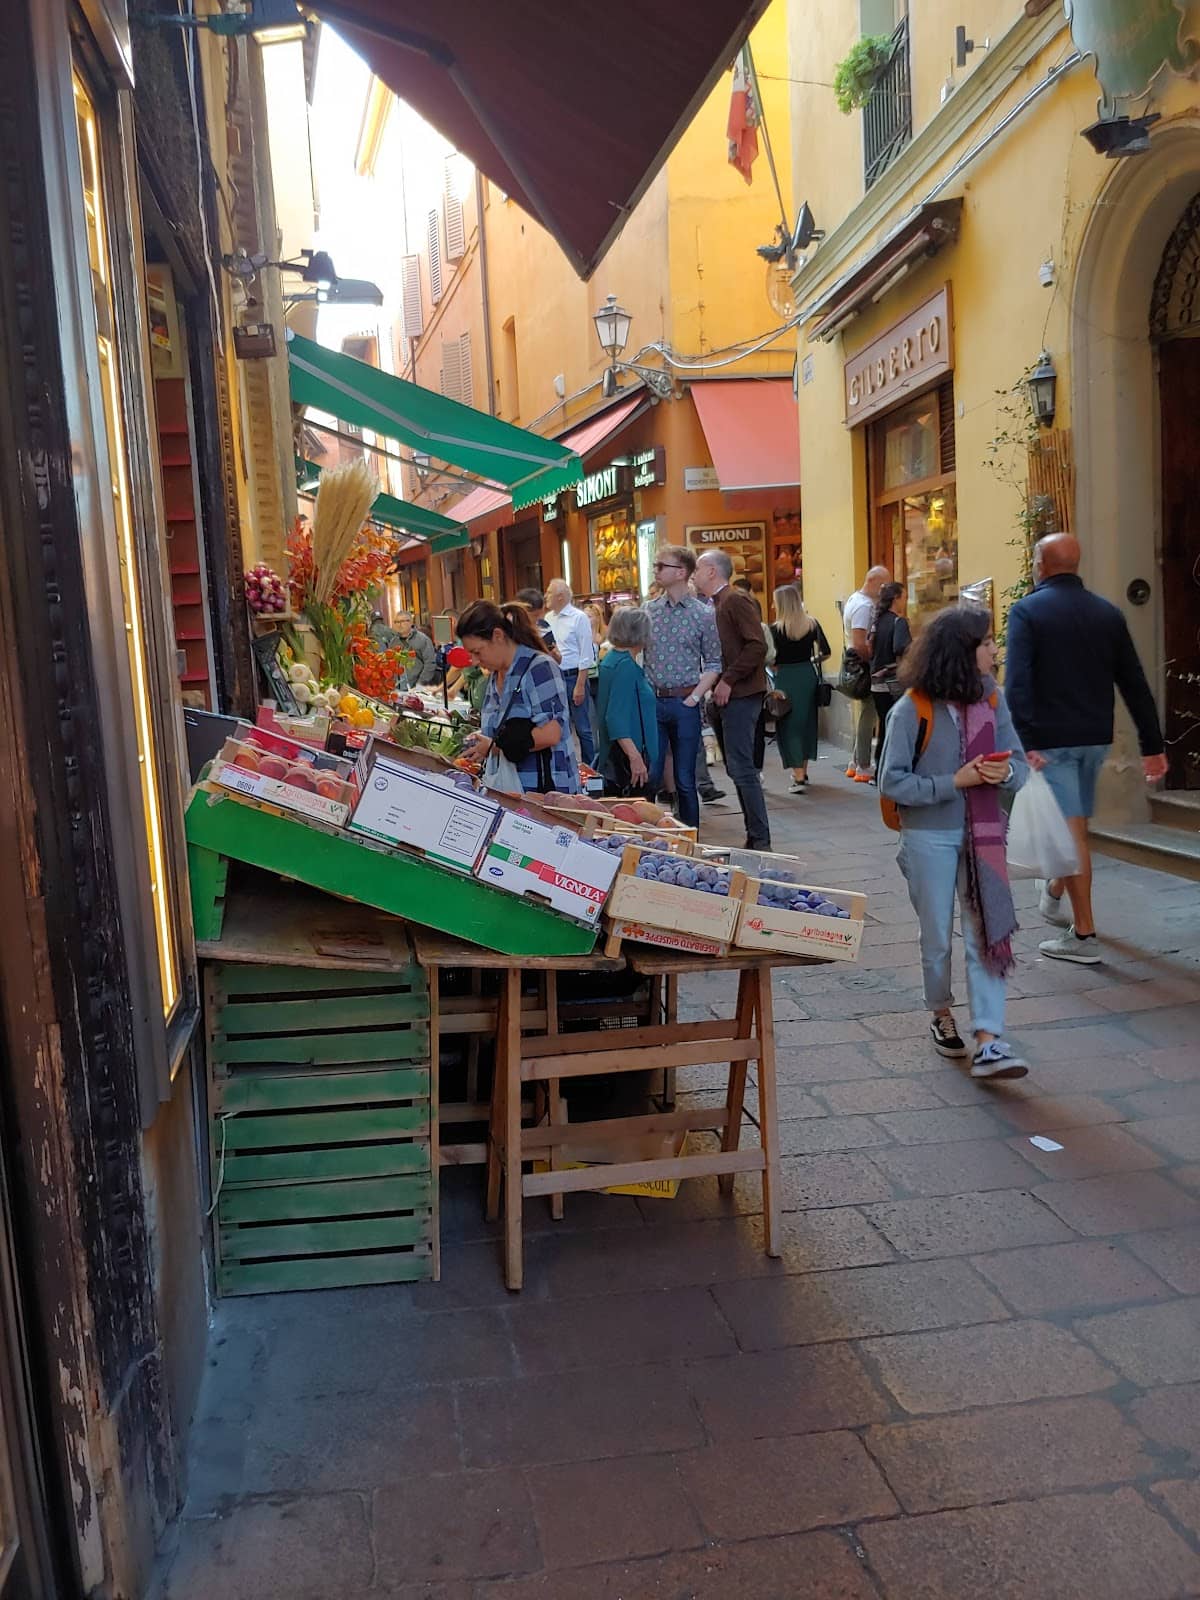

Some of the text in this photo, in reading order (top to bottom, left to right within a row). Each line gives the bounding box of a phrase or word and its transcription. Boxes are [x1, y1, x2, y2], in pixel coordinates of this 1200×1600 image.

[849, 316, 940, 405] GILBERTO
[576, 466, 617, 508] SIMONI
[701, 528, 750, 543] SIMONI
[555, 874, 602, 902] VIGNOLA
